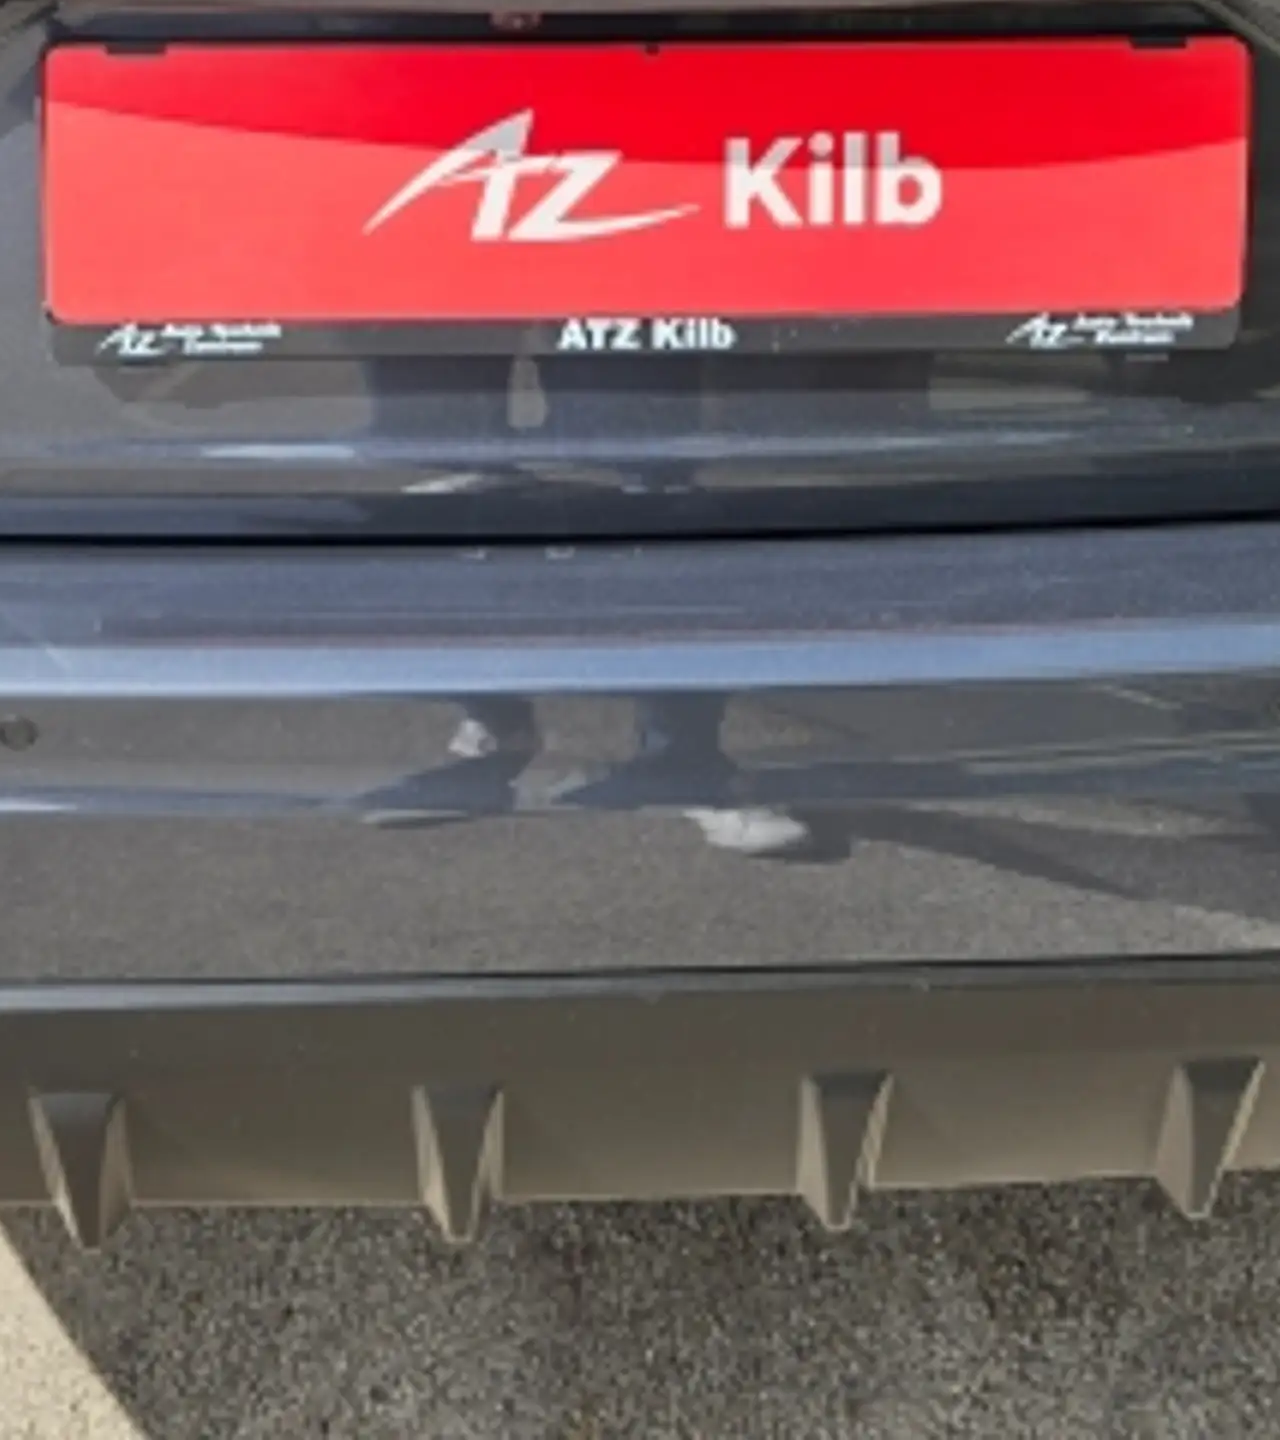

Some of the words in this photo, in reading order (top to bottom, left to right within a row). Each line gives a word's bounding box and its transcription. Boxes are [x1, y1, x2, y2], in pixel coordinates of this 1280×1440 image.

[723, 131, 943, 229] Kilb
[556, 317, 642, 351] ATZ
[650, 316, 738, 351] Kilb
